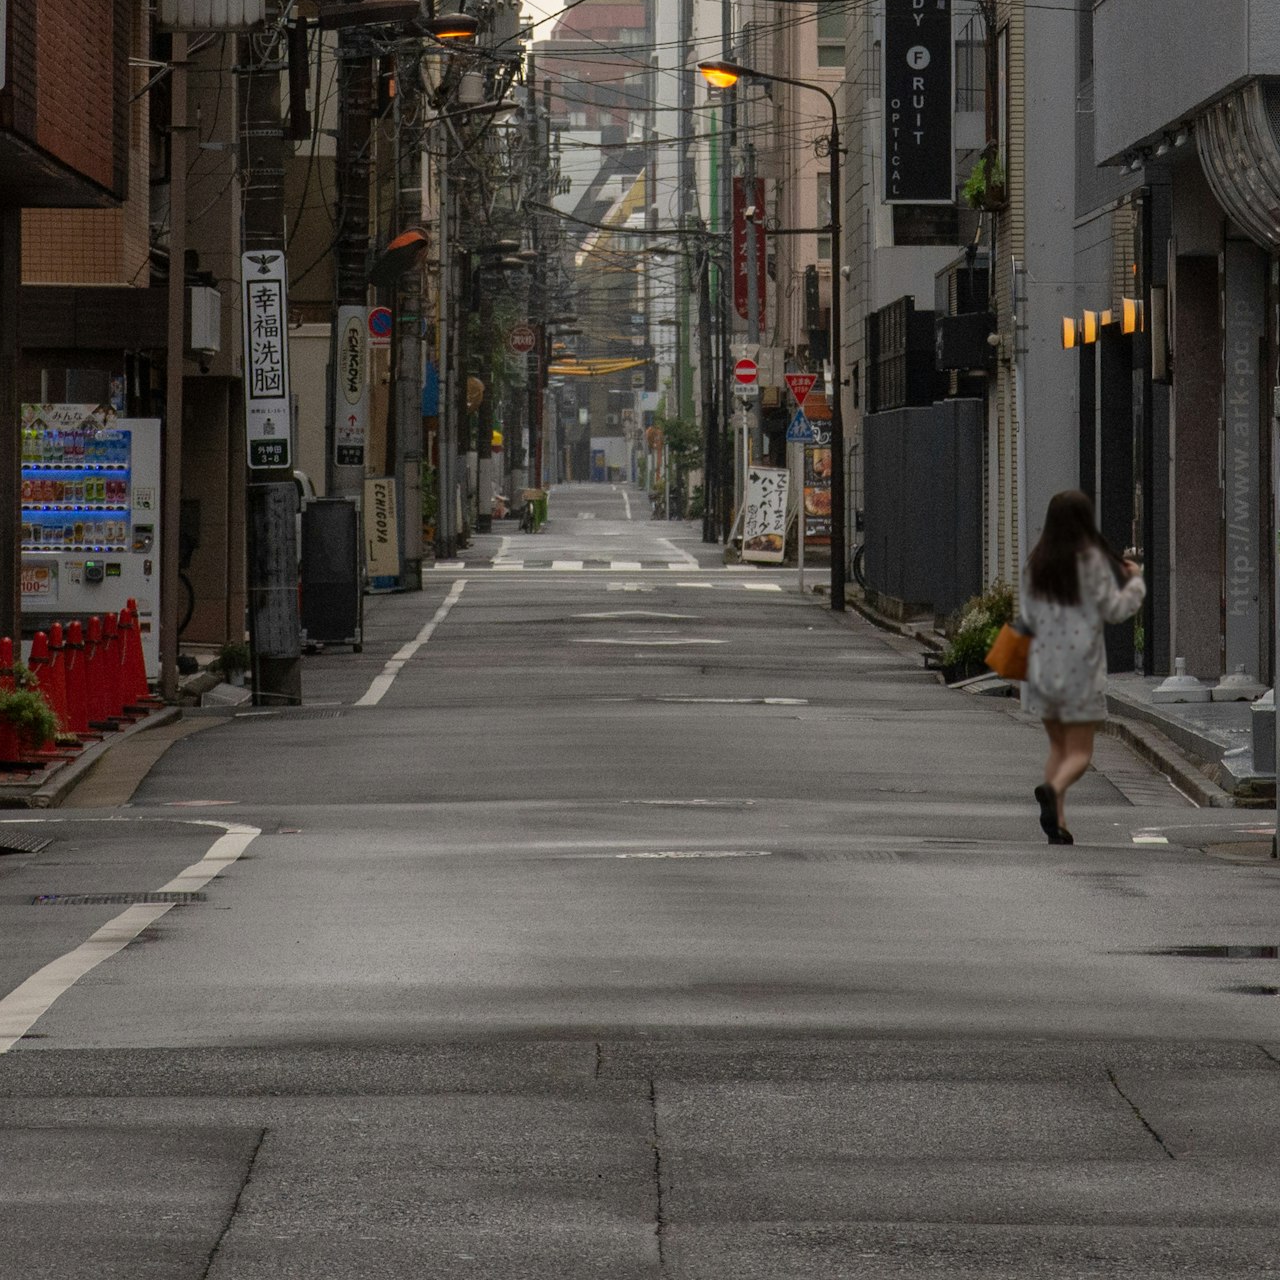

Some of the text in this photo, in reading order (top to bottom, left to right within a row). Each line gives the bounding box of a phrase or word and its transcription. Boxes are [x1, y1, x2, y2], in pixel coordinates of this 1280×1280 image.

[890, 98, 901, 195] OPTICAL
[1230, 297, 1260, 618] http://www.ark-pc.jp
[375, 484, 388, 544] ECHIGOYA
